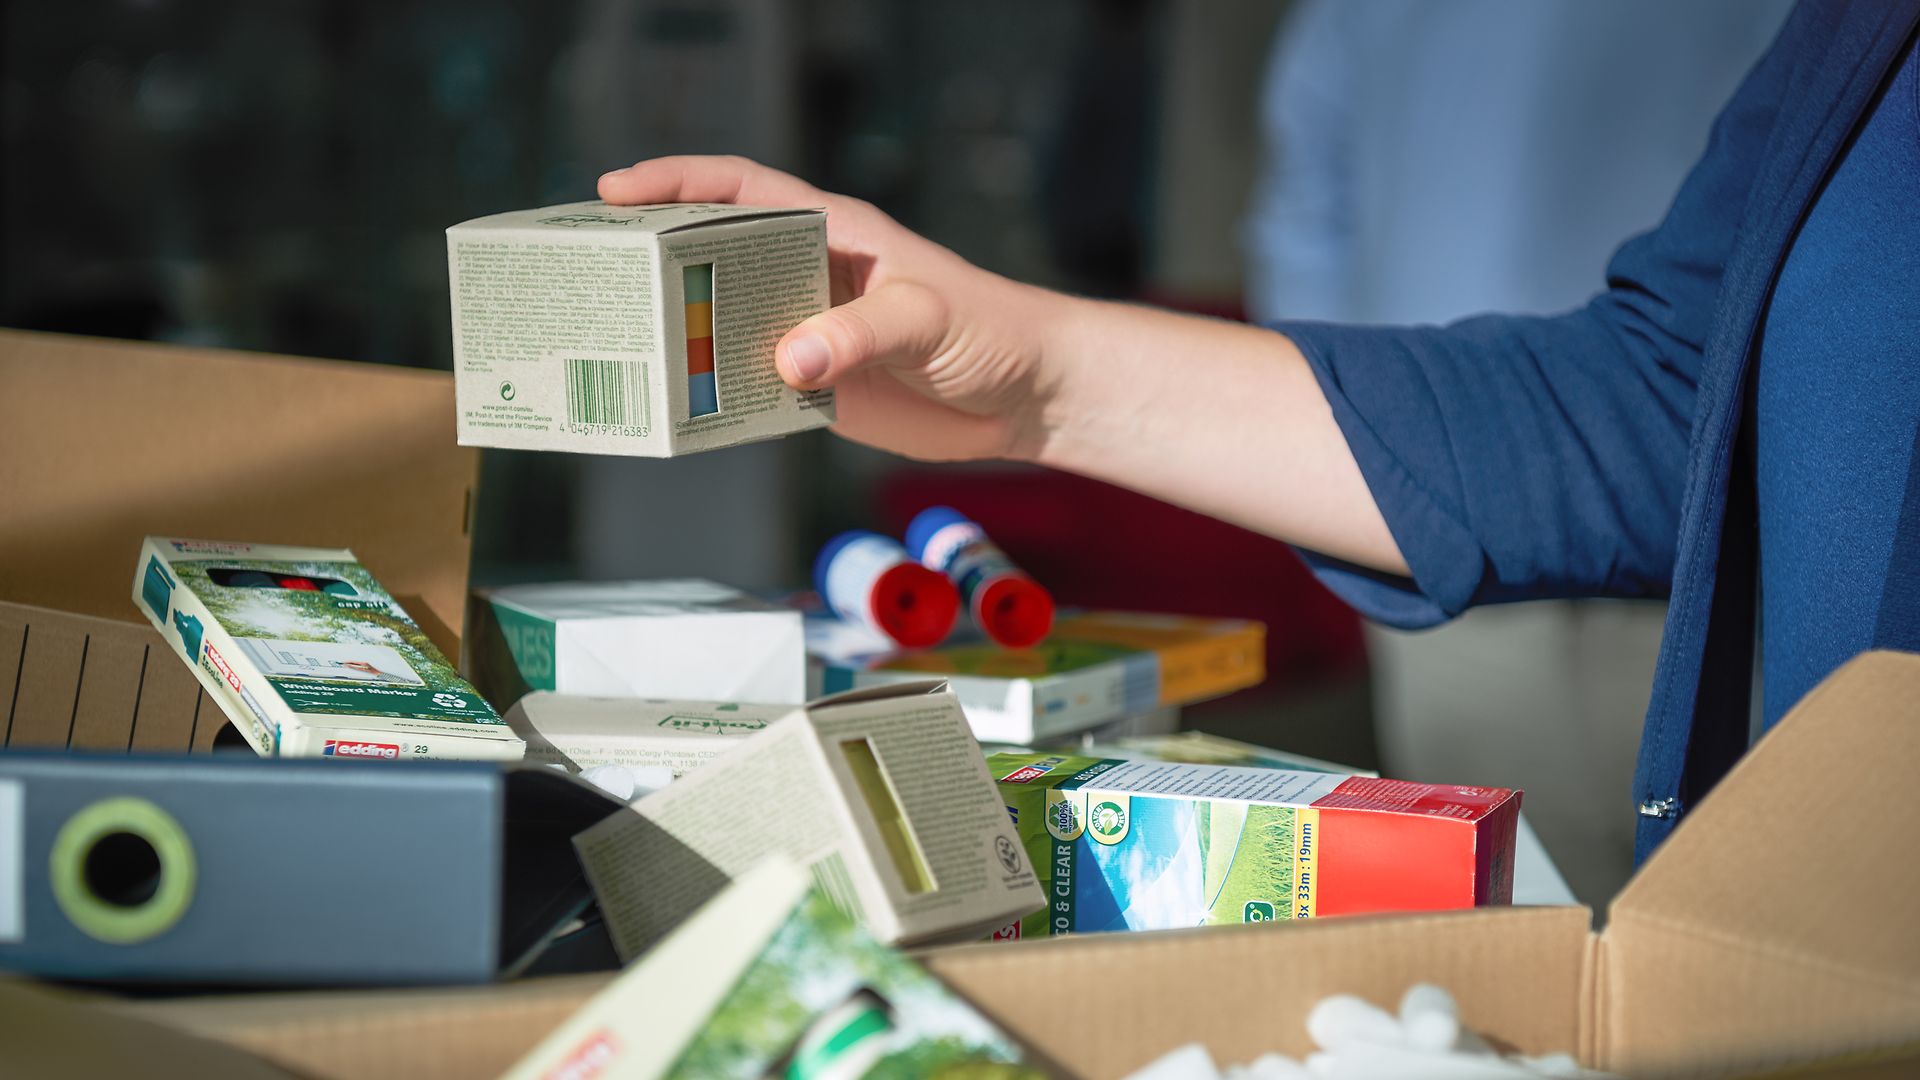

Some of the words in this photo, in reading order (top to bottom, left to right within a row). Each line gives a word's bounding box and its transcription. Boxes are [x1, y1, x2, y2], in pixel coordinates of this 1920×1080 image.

[477, 420, 506, 428] trademarks
[571, 423, 607, 435] 046719
[612, 425, 648, 437] 216383
[338, 601, 361, 609] cap
[280, 682, 365, 693] Whiteboard
[367, 688, 418, 697] Marker
[337, 743, 397, 759] edding
[414, 745, 428, 754] 29
[639, 749, 661, 758] Cergy
[1059, 803, 1068, 829] 100%
[1093, 803, 1105, 831] SOLVENT
[1117, 810, 1126, 828] FREE
[1299, 823, 1312, 863] 19mm
[1056, 845, 1071, 897] CLEAR
[1298, 872, 1310, 901] 33m
[1056, 901, 1070, 912] &
